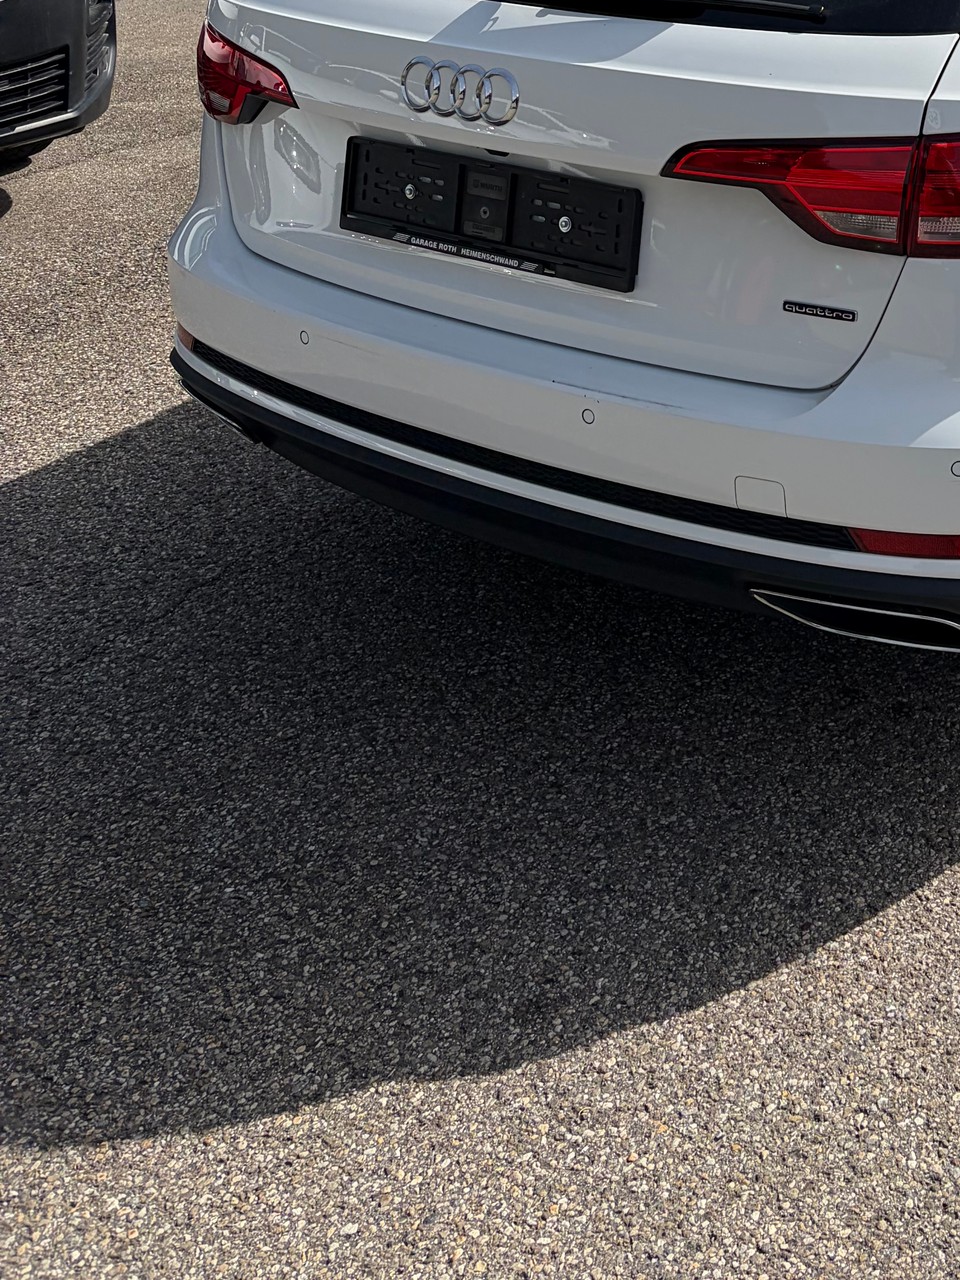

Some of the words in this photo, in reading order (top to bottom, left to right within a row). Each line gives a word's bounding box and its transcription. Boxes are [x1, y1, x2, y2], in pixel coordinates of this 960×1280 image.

[411, 236, 438, 250] GARAGE
[438, 243, 458, 254] ROTH
[460, 247, 519, 268] HEIMENSCHWAND
[785, 303, 853, 320] quattro
